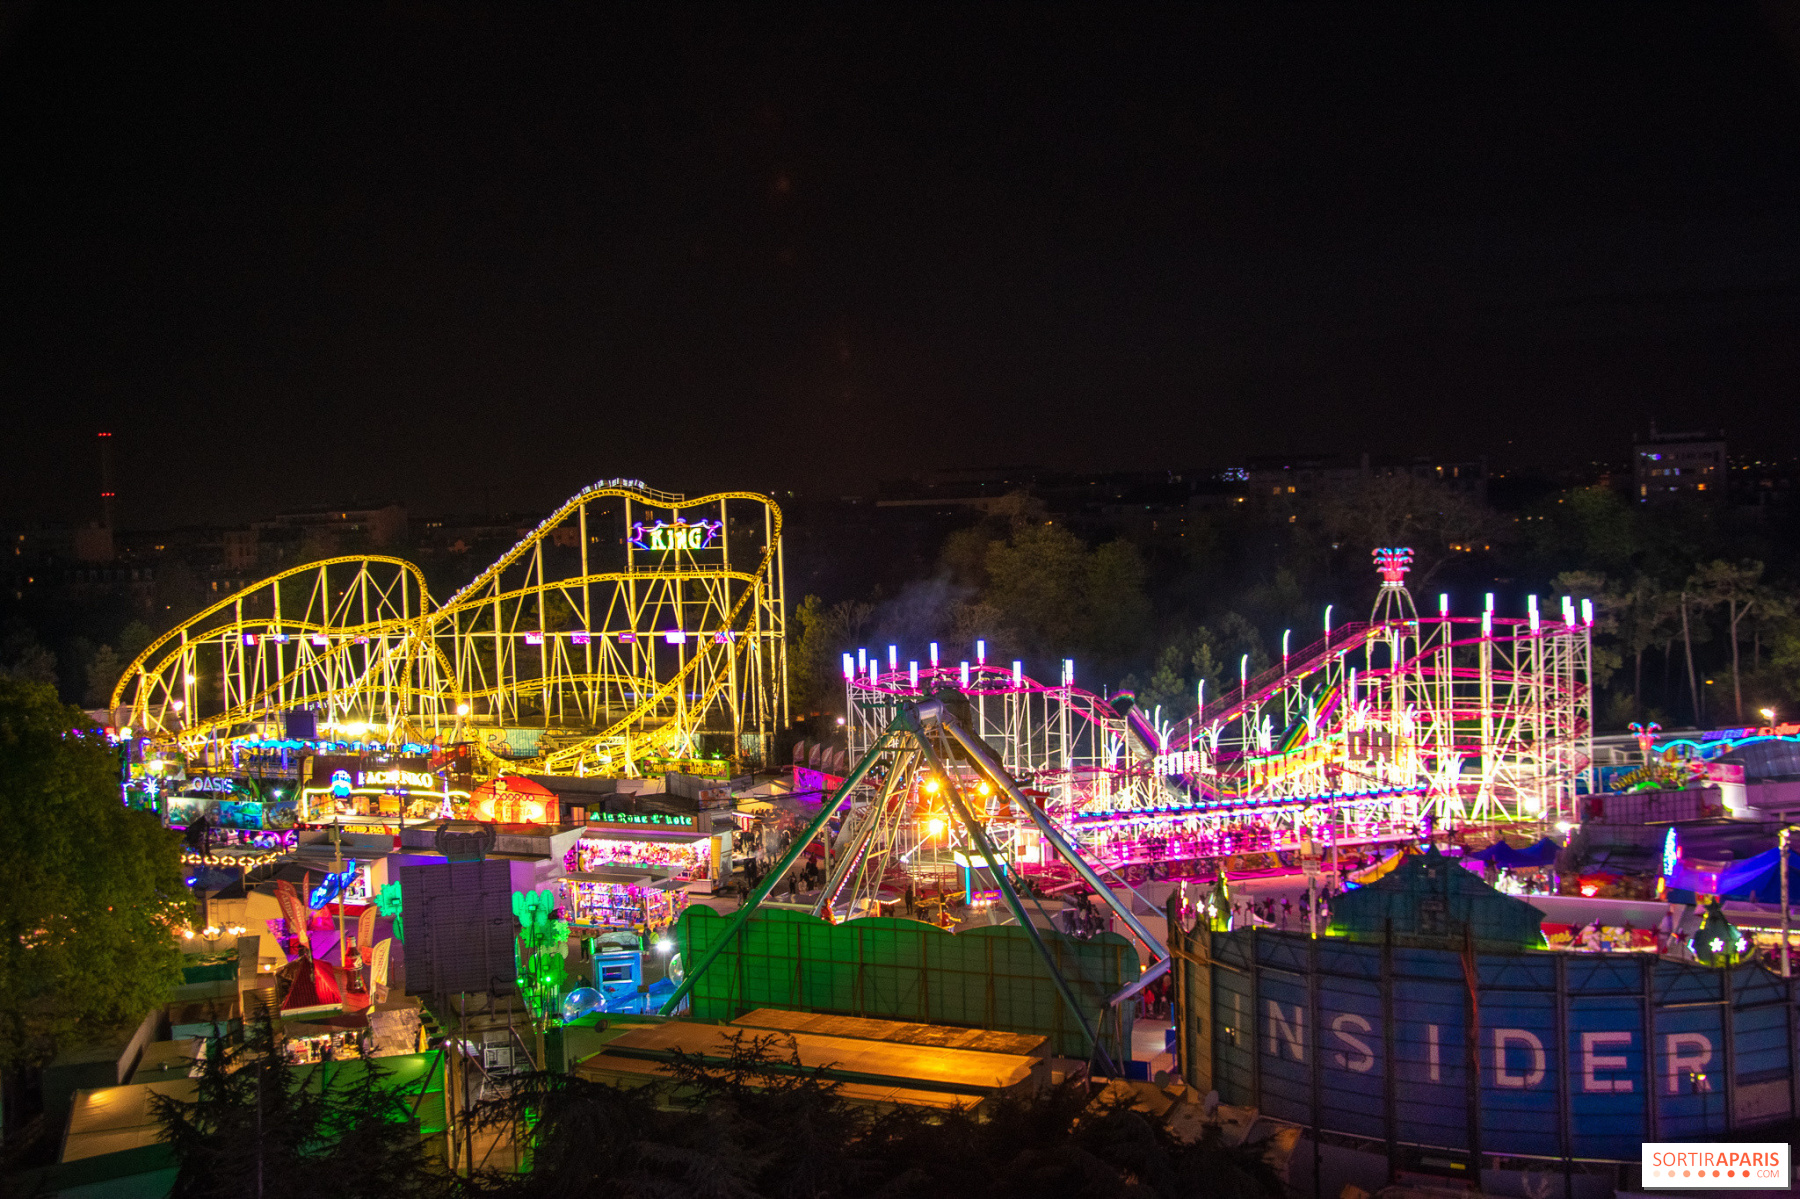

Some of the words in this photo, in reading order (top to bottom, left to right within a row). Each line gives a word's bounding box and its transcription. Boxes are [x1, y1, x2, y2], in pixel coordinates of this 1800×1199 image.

[650, 527, 702, 550] KING
[192, 777, 234, 794] OASIS
[1233, 993, 1714, 1094] INSIDER
